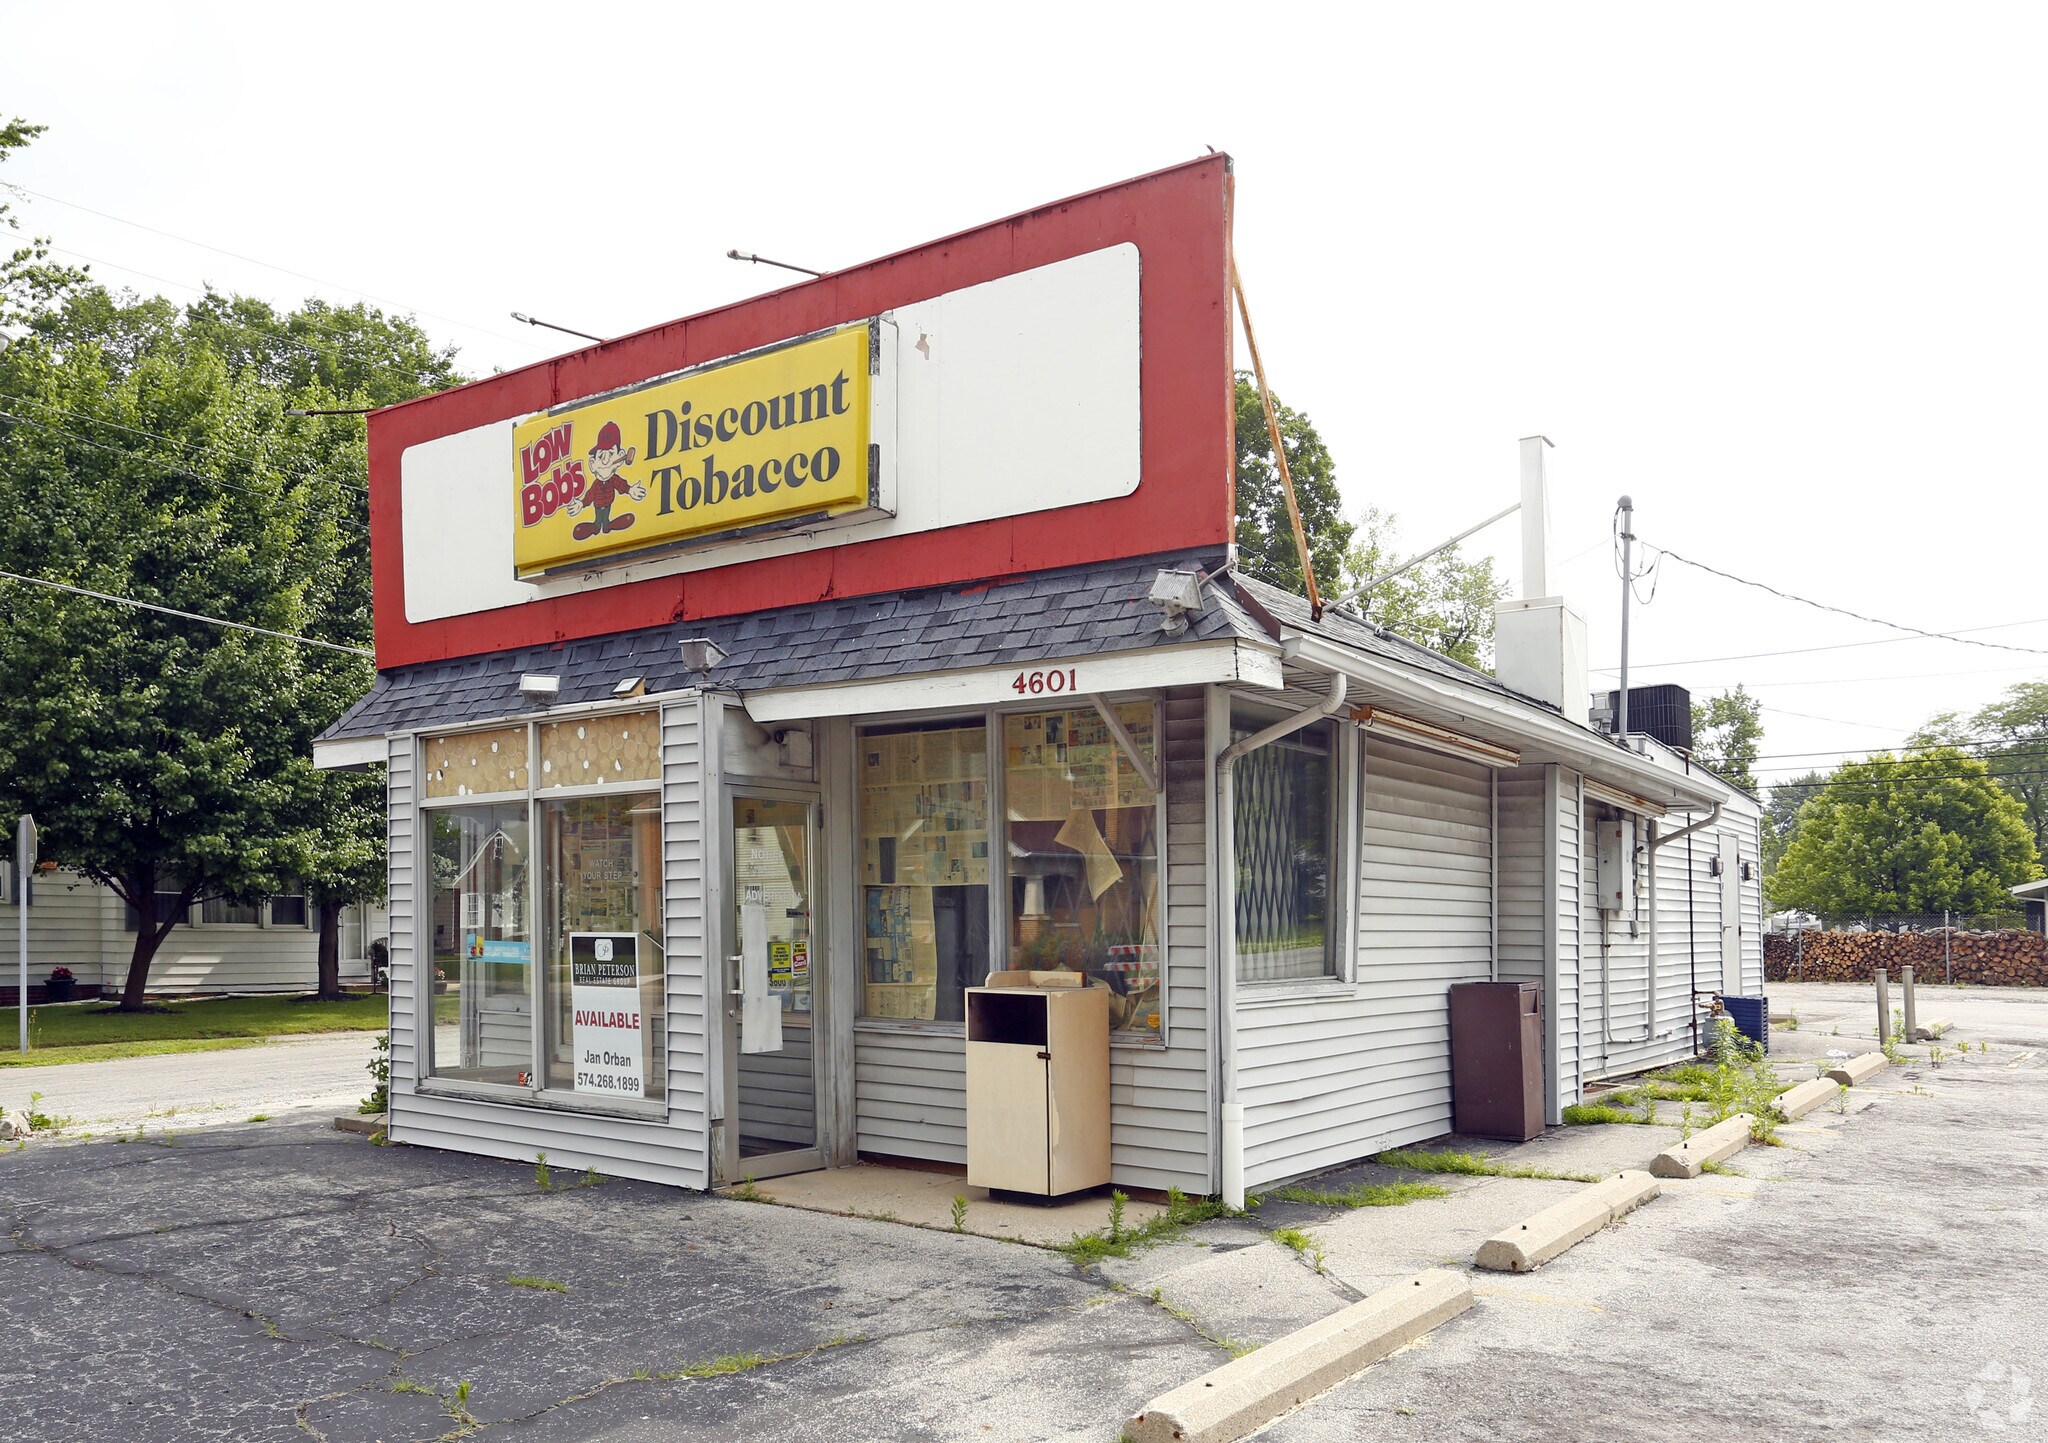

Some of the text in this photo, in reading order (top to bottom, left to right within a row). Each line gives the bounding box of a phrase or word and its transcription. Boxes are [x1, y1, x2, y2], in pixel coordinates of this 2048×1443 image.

[644, 368, 851, 462] Discount
[520, 421, 574, 486] LOW
[650, 446, 841, 517] Tobacco
[1011, 668, 1077, 694] 4601
[588, 858, 614, 868] WATCH
[583, 871, 623, 880] YOUR STEP
[575, 963, 635, 976] BRIAN PETERSON
[579, 976, 630, 986] REAL ESTATE GROUP
[575, 1010, 640, 1029] AVAILABLE
[584, 1050, 631, 1067] Jan Orban
[577, 1072, 640, 1092] 574.268.1899
